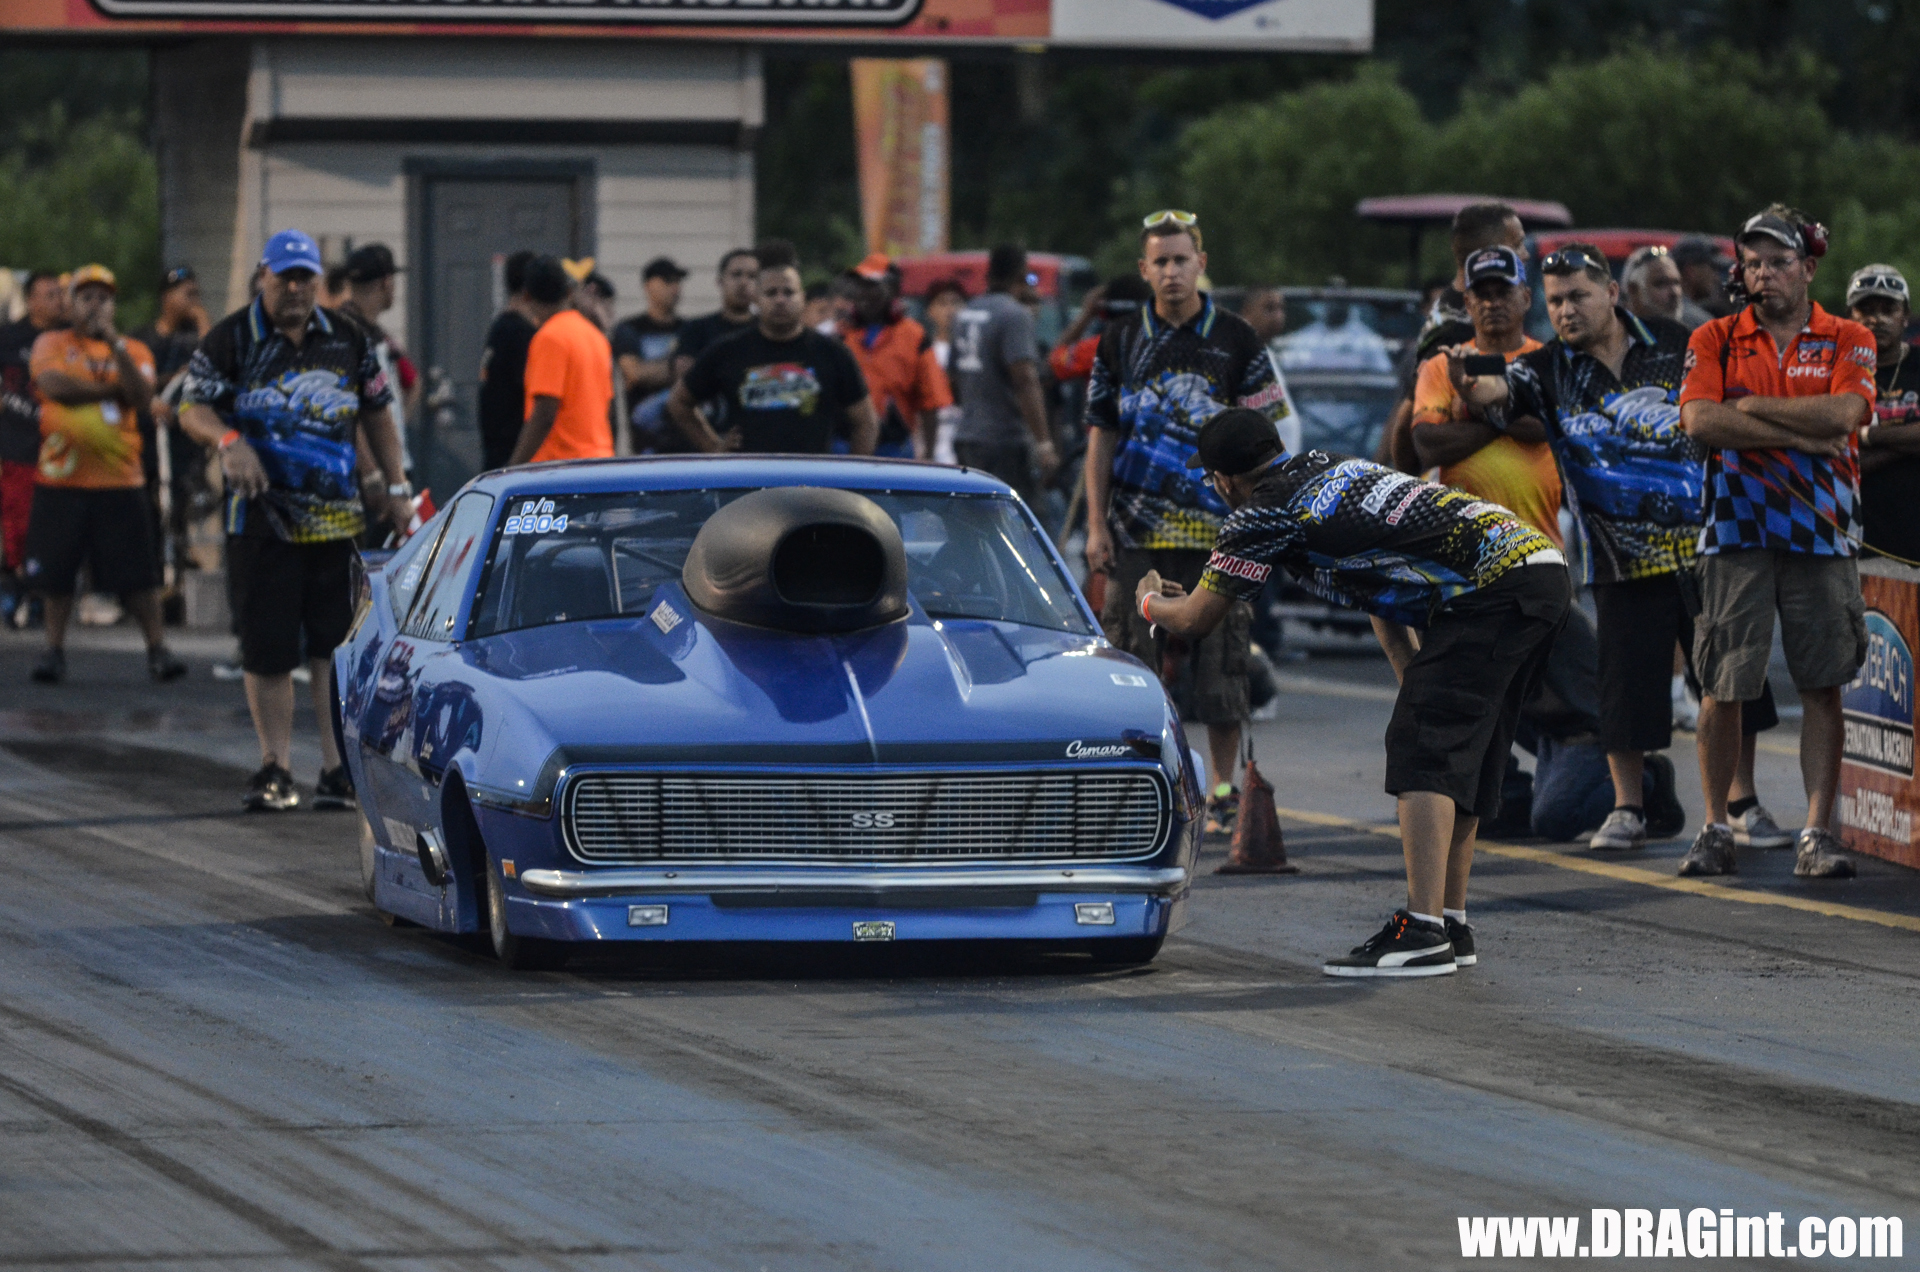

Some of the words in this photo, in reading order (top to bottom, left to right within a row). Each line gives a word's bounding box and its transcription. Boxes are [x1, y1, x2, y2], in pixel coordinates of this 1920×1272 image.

[521, 497, 555, 516] p/n
[504, 514, 568, 534] 2804
[1870, 633, 1907, 713] BEACH
[1066, 740, 1132, 759] Camaro
[852, 810, 895, 828] SS
